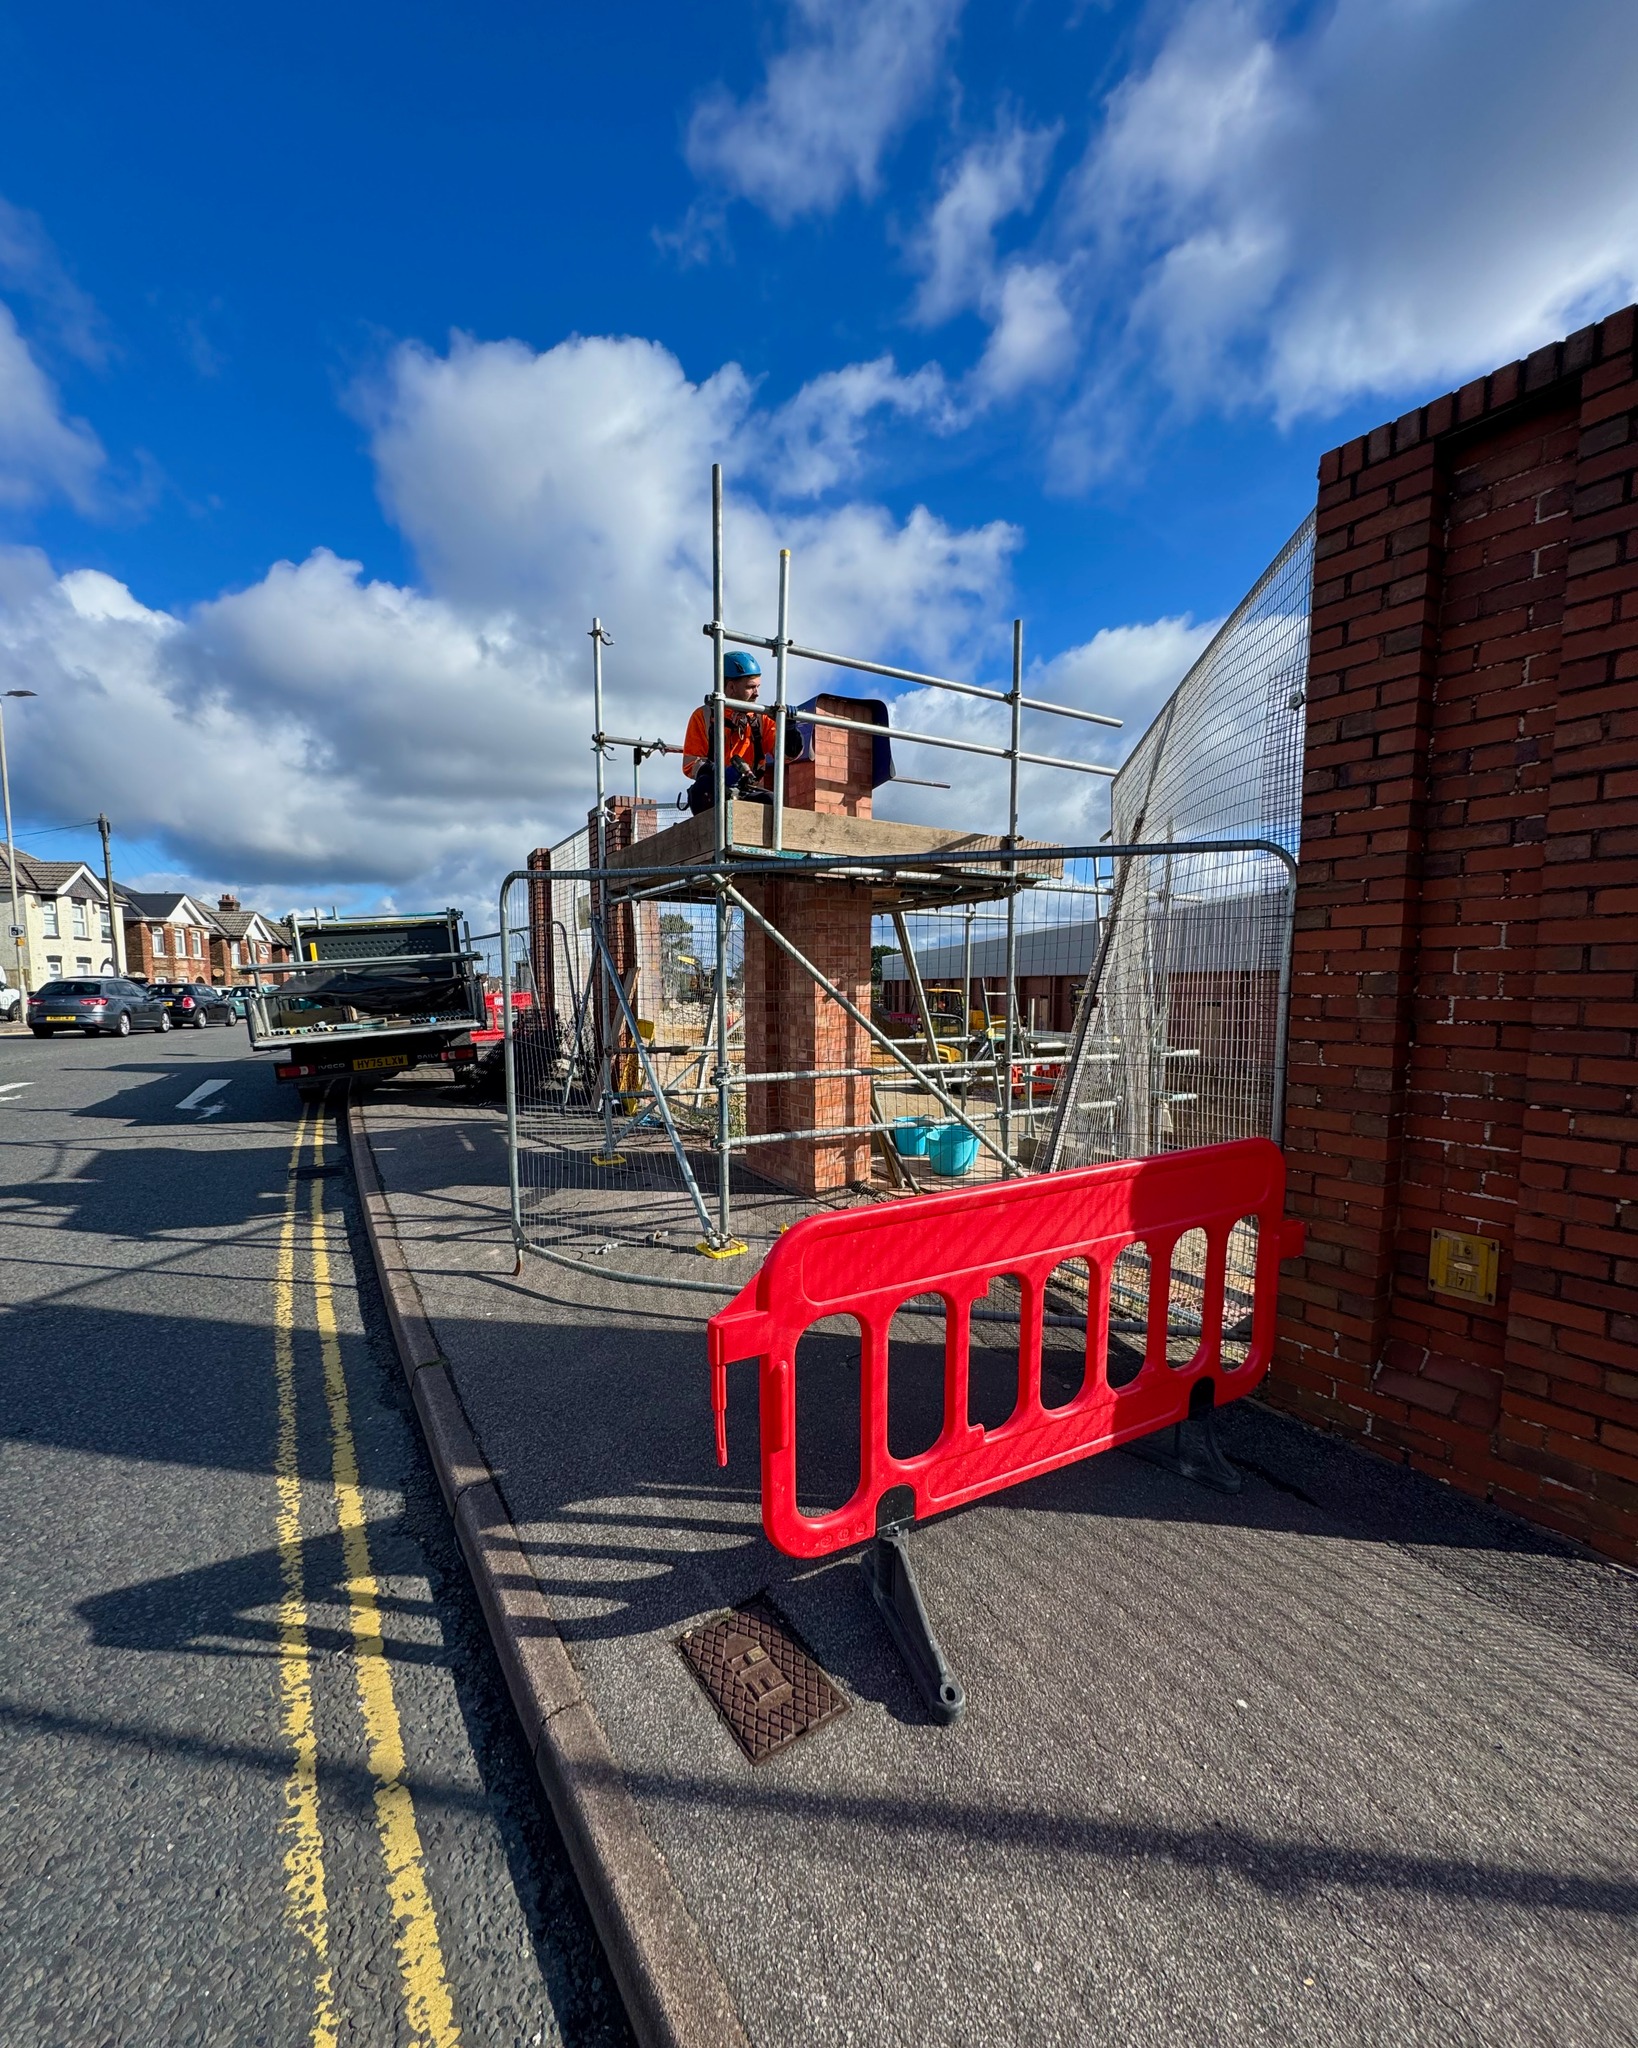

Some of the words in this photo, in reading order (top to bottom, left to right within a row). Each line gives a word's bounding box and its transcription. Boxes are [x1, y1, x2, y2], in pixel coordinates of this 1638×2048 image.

[318, 1062, 346, 1070] IVECO
[357, 1059, 383, 1069] HY75
[385, 1056, 404, 1065] LXW
[1458, 1277, 1464, 1286] 7
